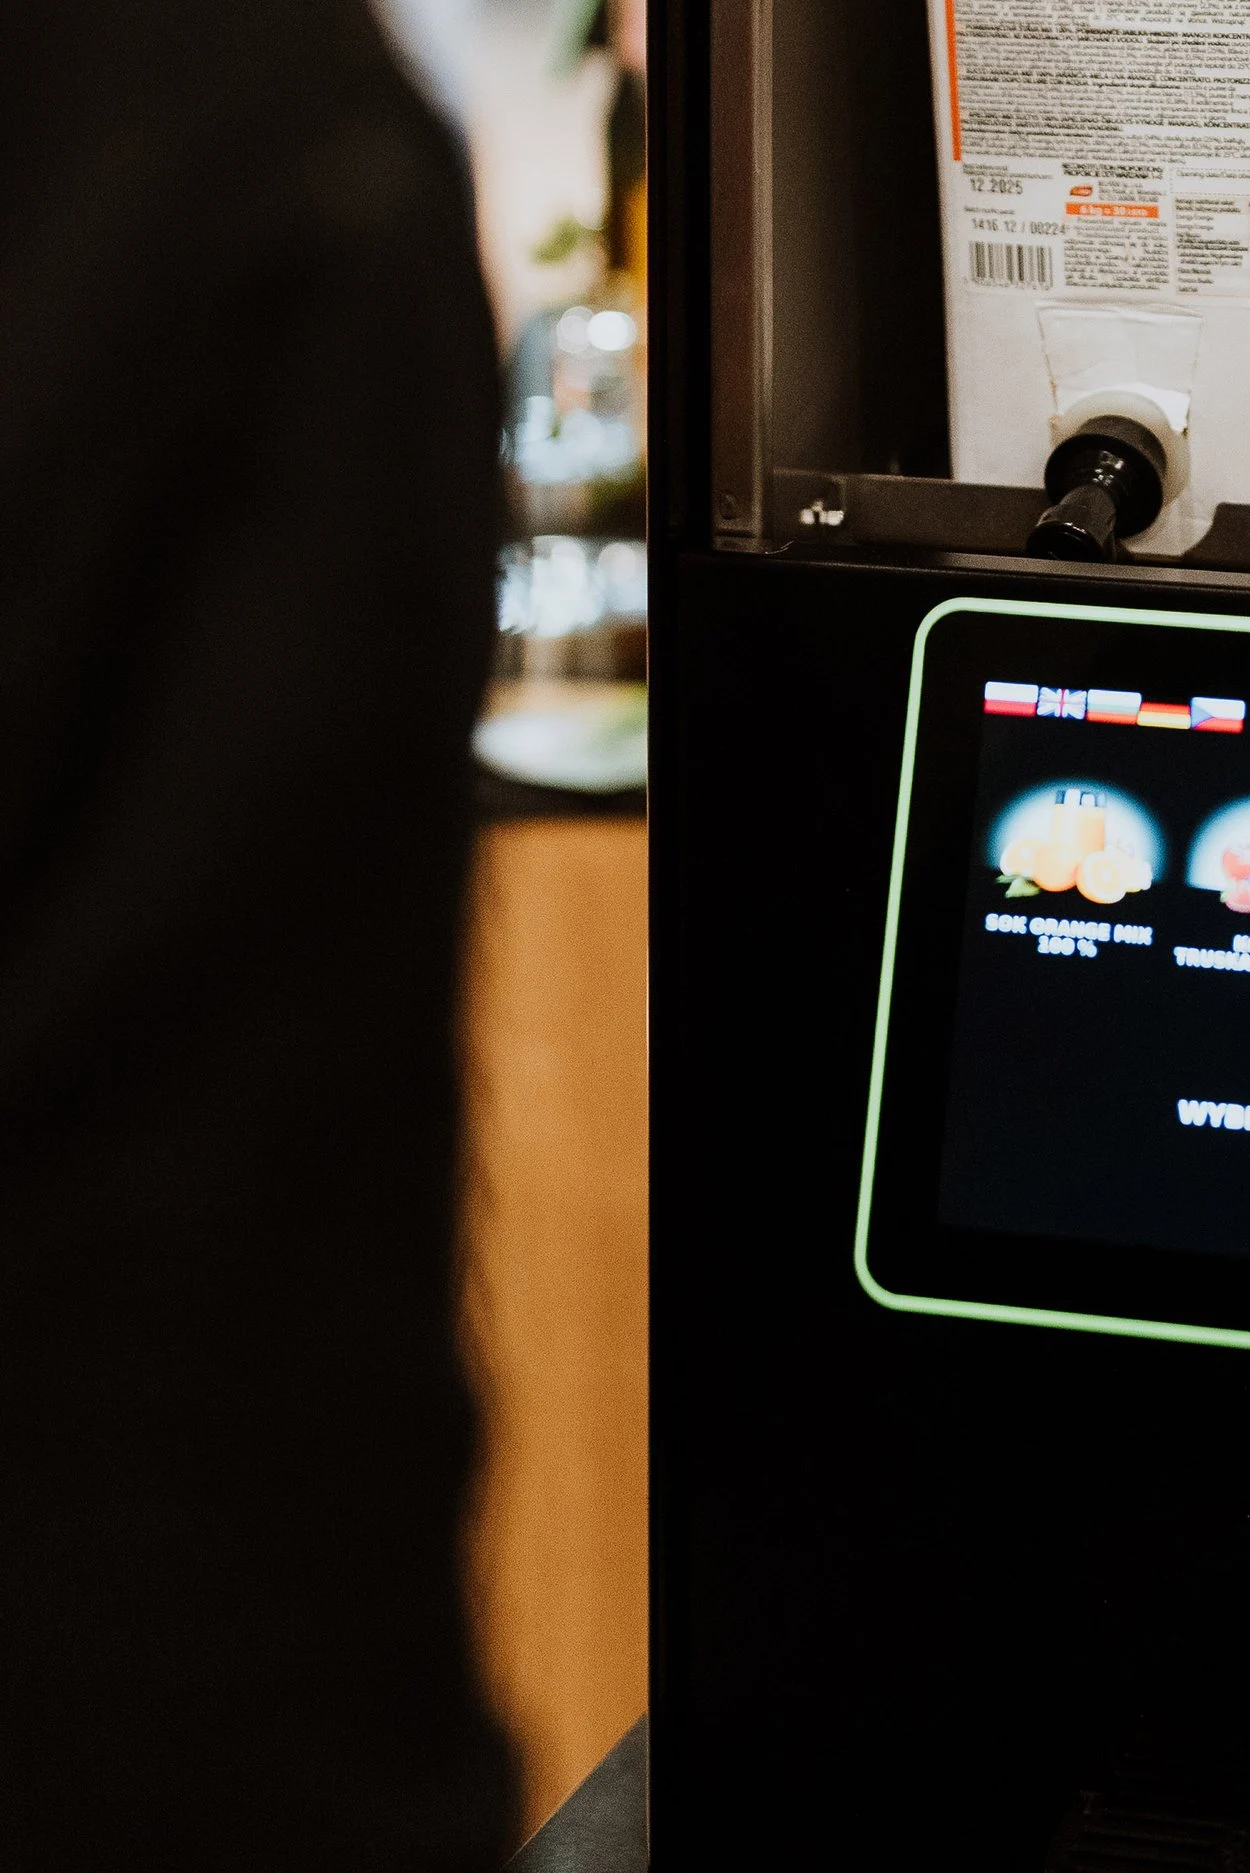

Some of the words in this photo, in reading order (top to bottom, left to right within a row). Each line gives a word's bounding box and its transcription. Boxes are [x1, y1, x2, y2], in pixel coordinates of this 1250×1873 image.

[970, 178, 1023, 194] 12.2025
[985, 913, 1027, 933] SOK
[1030, 917, 1110, 941] ORANGE
[1114, 924, 1152, 945] MIX
